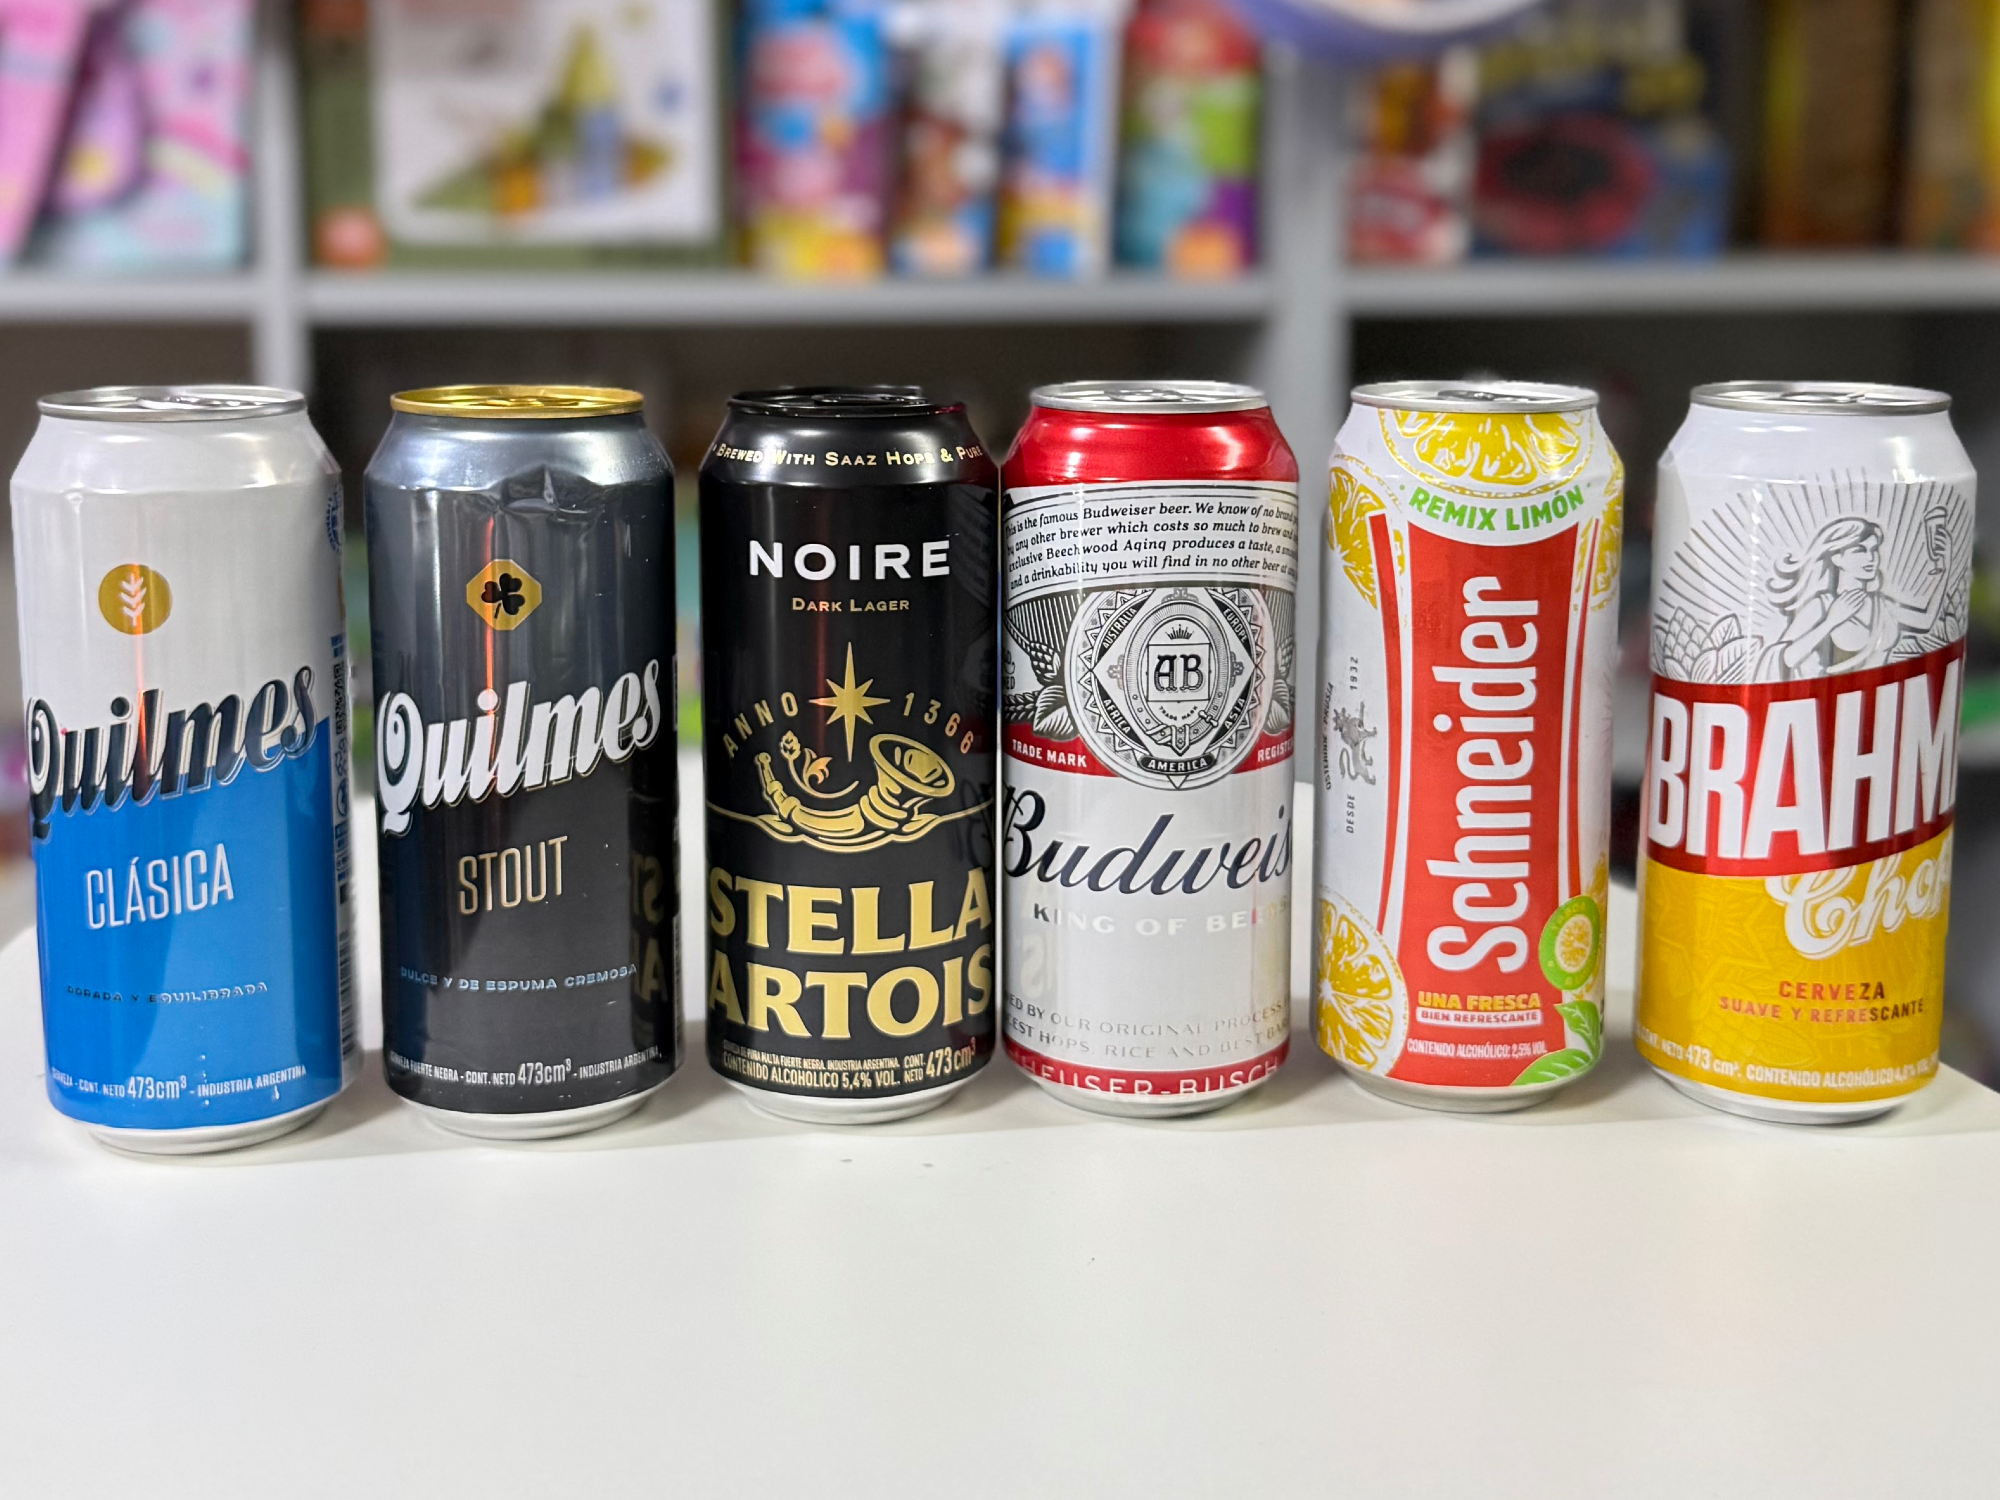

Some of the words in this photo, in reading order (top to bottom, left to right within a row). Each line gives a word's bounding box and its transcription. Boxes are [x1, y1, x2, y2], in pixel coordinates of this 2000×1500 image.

[940, 447, 954, 463] &
[1017, 520, 1023, 532] is
[1024, 516, 1037, 530] the
[1039, 512, 1079, 528] famous
[1083, 503, 1156, 520] Budweiser
[1159, 502, 1192, 514] beer.
[1195, 502, 1214, 514] We
[1217, 501, 1250, 515] know
[1251, 504, 1263, 518] of
[1263, 508, 1274, 518] no
[1408, 486, 1496, 531] REMIX
[1506, 484, 1585, 531] LIMÓN
[1015, 538, 1029, 551] any
[1031, 532, 1056, 546] other
[1059, 526, 1102, 540] brewer
[1108, 520, 1148, 534] which
[1153, 520, 1189, 532] costs
[1193, 522, 1208, 531] so
[1212, 519, 1245, 533] much
[1248, 521, 1259, 533] to
[1262, 522, 1281, 536] brew
[1123, 538, 1167, 552] Aging
[1172, 536, 1235, 551] produces
[1238, 541, 1246, 550] a
[1248, 539, 1274, 554] taste,
[1276, 545, 1281, 554] a
[749, 539, 951, 581] NOIRE
[1024, 574, 1030, 585] a
[1031, 560, 1098, 582] drinkability
[1102, 560, 1127, 573] you
[1132, 556, 1158, 569] will
[1161, 555, 1191, 569] find
[1195, 555, 1208, 567] in
[1212, 558, 1228, 567] no
[1232, 556, 1260, 569] other
[1262, 558, 1280, 571] beer
[792, 597, 842, 612] DARK
[850, 598, 910, 612] LAGER
[1102, 607, 1138, 649] AUSTRALIA
[1223, 608, 1248, 643] EUROPE
[1349, 656, 1359, 691] 1932
[722, 691, 799, 758] ANNO
[903, 692, 974, 754] 1366
[1103, 698, 1132, 734] AFRICA
[1224, 698, 1245, 729] ASIA
[26, 665, 318, 844] Quilmes
[376, 659, 662, 838] Quilmes
[1012, 738, 1043, 760] TRADE
[1047, 749, 1088, 768] MARK
[1648, 658, 1960, 861] BRAHM
[1147, 759, 1208, 772] AMERICA
[1426, 576, 1539, 974] Schneider
[1346, 794, 1356, 834] DESDE
[85, 843, 234, 930] CLÁSICA
[458, 835, 568, 915] STOUT
[709, 866, 992, 955] STELLA
[1033, 902, 1115, 935] KING
[1135, 917, 1188, 936] OF
[66, 985, 123, 1002] DORADA
[148, 981, 268, 1004] EQUILIBRADA
[400, 966, 438, 985] DULCE
[442, 977, 453, 988] Y
[457, 978, 480, 991] DE
[485, 978, 558, 991] ESPUMA
[564, 963, 638, 988] CREMOSA
[708, 944, 992, 1039] ARTOIS
[1778, 980, 1886, 1001] CERVEZA
[1418, 990, 1462, 1010] UNA
[1466, 992, 1541, 1011] FRESCA
[1719, 996, 1781, 1019] SUAVE
[1791, 1002, 1802, 1022] Y
[1809, 998, 1924, 1024] REFRESCANTE
[1027, 1003, 1045, 1019] BY
[1050, 1012, 1091, 1031] OUR
[1100, 1021, 1201, 1036] ORIGINAL
[1421, 1010, 1450, 1021] BIEN
[1453, 1010, 1538, 1023] REFRESCANTE
[780, 1054, 802, 1068] FUERTE
[827, 1059, 861, 1072] INDUSTRIA
[903, 1053, 926, 1069] CONT.
[1105, 1044, 1156, 1058] RICE
[1407, 1038, 1454, 1057] CONTENIDO
[102, 1083, 126, 1098] NETO
[197, 1077, 253, 1098] INDUSTRIA
[255, 1064, 307, 1088] ARGENTINA
[410, 1058, 433, 1077] FUERTE
[433, 1066, 459, 1082] NEGRA
[465, 1071, 491, 1085] CONT.
[493, 1072, 516, 1086] NETO
[579, 1060, 623, 1080] INDUSTRIA
[723, 1051, 769, 1080] CONTENIDO
[771, 1066, 839, 1088] ALCOHOLICO
[841, 1070, 872, 1091] 5,4%
[874, 1070, 901, 1087] VOL.
[904, 1068, 923, 1083] NETO
[1746, 1063, 1820, 1088] CONTENIDO
[1823, 1067, 1894, 1088] ALCOHÓLICO
